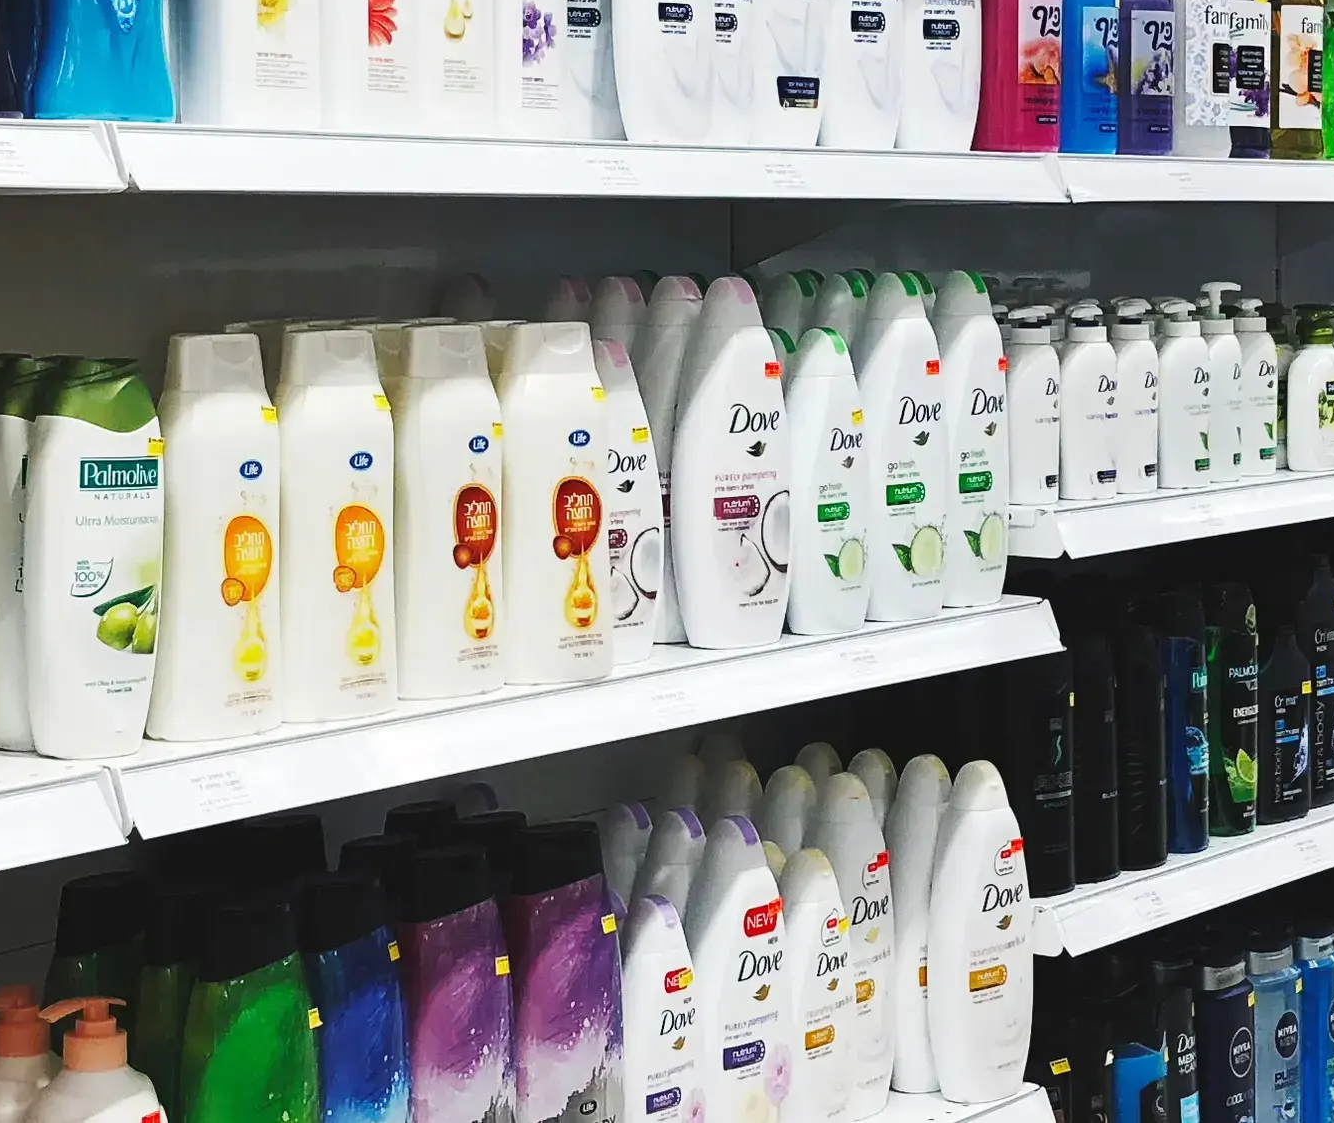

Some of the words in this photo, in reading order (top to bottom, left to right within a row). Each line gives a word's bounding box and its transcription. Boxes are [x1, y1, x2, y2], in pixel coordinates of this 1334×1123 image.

[970, 388, 1004, 415] Dove
[899, 397, 941, 425] Dove
[730, 404, 779, 433] Dove
[472, 438, 486, 450] Life
[572, 432, 588, 445] Life
[830, 429, 863, 451] Dove
[353, 454, 371, 467] Life
[608, 449, 647, 473] Dove
[960, 451, 970, 462] go
[84, 463, 157, 484] Palmolive
[244, 463, 259, 476] Life
[887, 461, 898, 472] go
[94, 492, 151, 500] NATURALS
[818, 484, 829, 494] go
[894, 487, 918, 496] nutrium
[564, 493, 593, 507] תחליב
[723, 500, 750, 509] nutrium
[464, 501, 491, 515] תחליב
[566, 506, 593, 519] רחצה
[76, 516, 101, 527] Ultra
[344, 521, 376, 535] תחליב
[466, 514, 490, 528] רחצה
[233, 531, 265, 547] תחליב
[346, 536, 375, 550] רחצה
[236, 546, 264, 561] רחצה
[74, 571, 105, 582] 100%
[1315, 700, 1326, 746] body
[982, 883, 1023, 912] Dove
[852, 896, 888, 925] Dove
[738, 950, 783, 982] Dove
[817, 952, 848, 977] Dove
[660, 1007, 696, 1036] Dove
[1278, 1025, 1298, 1038] NIVEA
[1233, 1041, 1251, 1056] NIVEA
